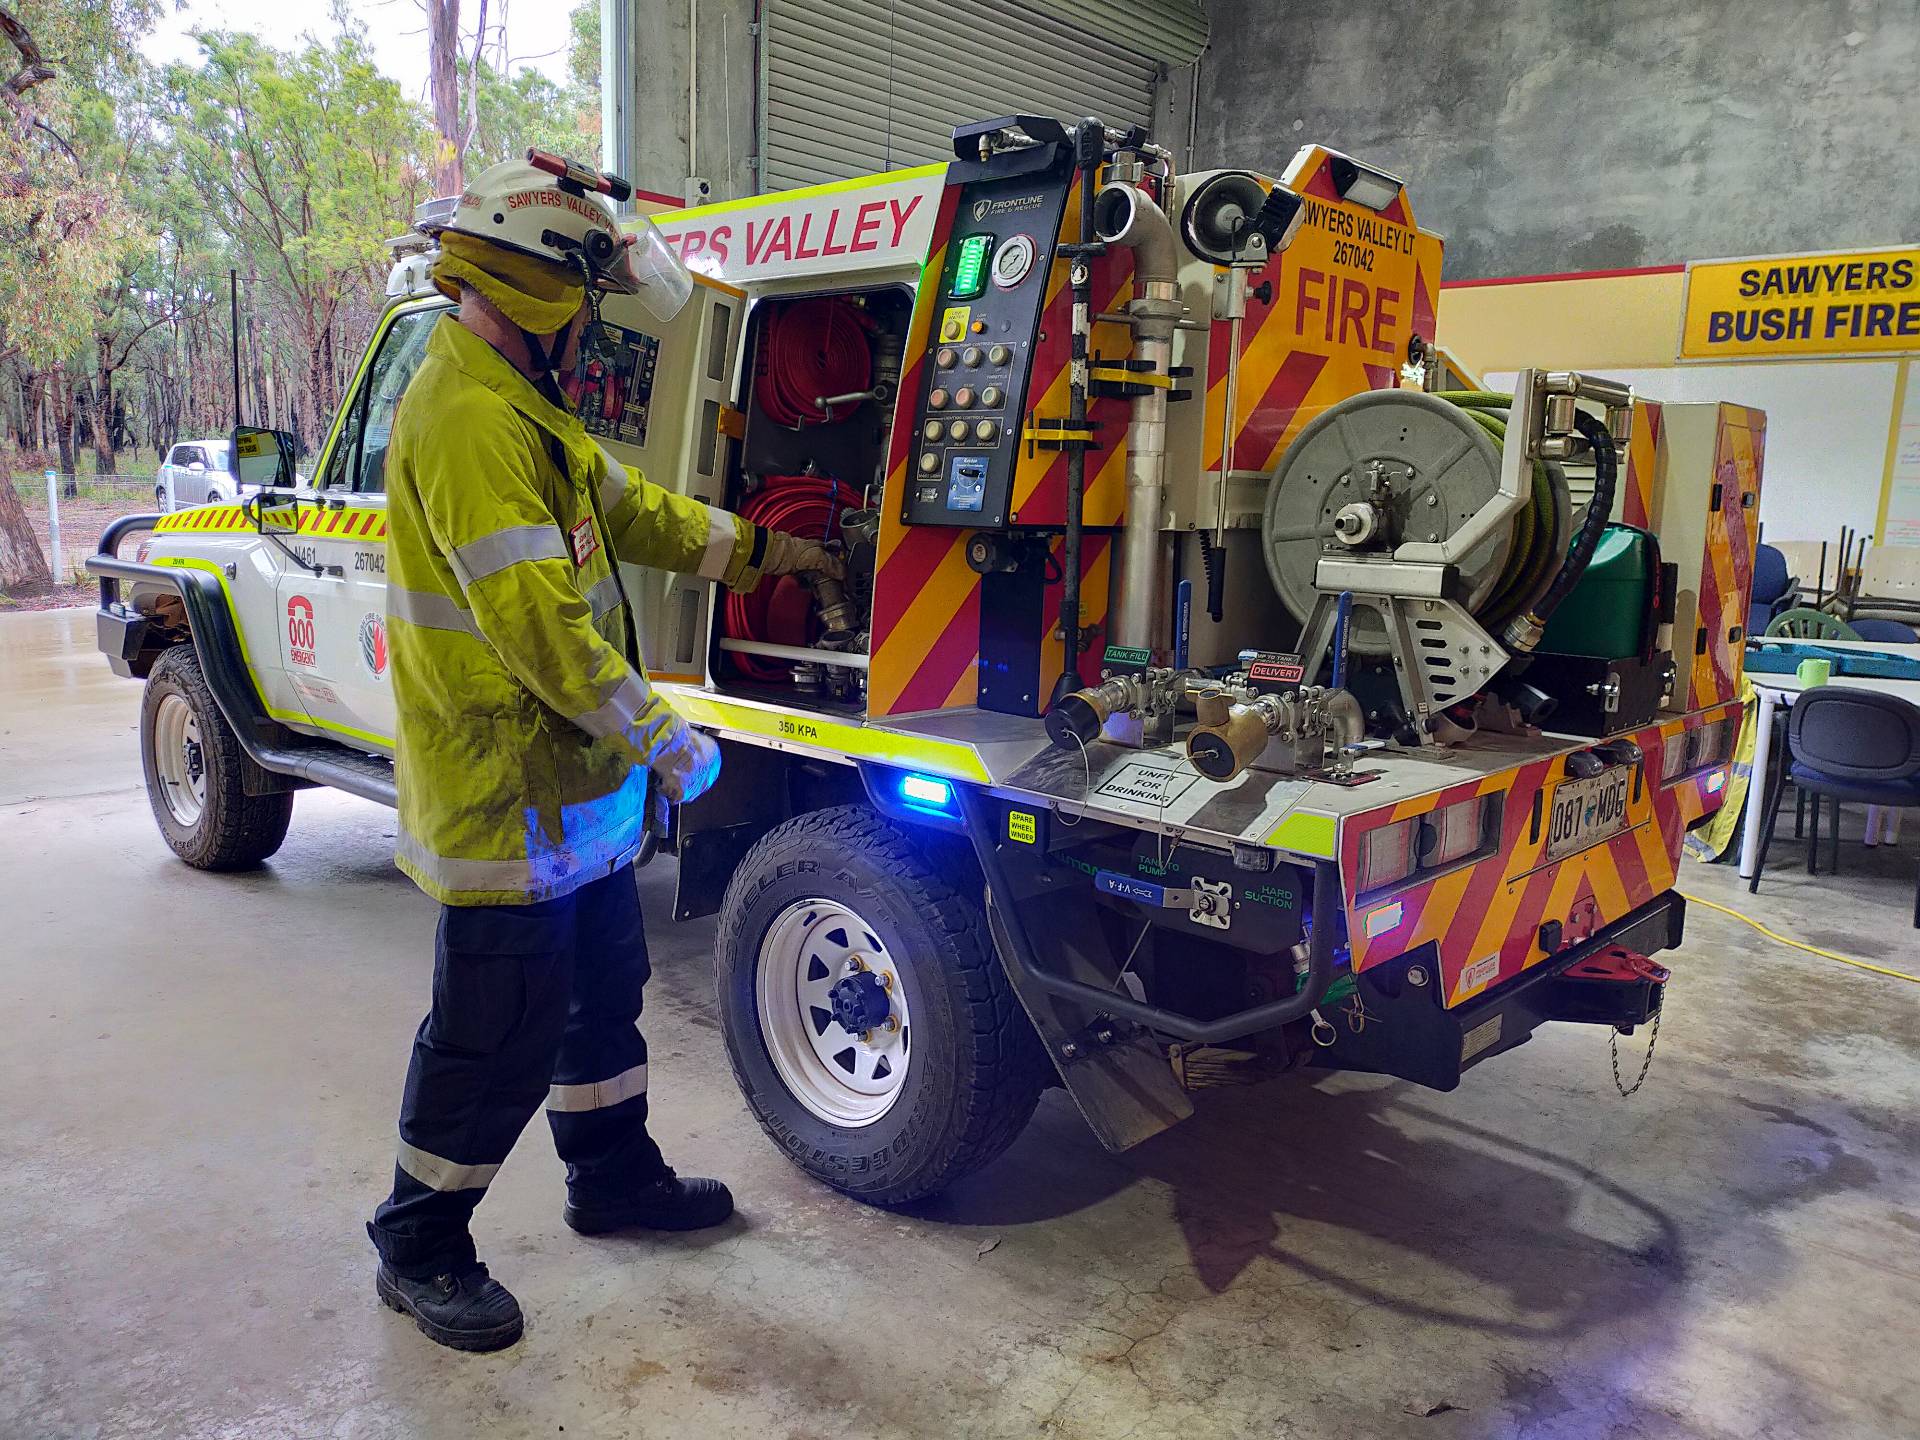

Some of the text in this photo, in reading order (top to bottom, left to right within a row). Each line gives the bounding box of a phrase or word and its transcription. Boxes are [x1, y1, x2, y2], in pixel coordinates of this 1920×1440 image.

[508, 191, 562, 209] SAWYERS
[566, 196, 602, 225] VALLEY
[992, 195, 1044, 209] FRONTLINE
[746, 195, 924, 266] VALLEY
[1357, 216, 1402, 253] VALLEY
[1403, 231, 1416, 256] LT
[1333, 240, 1375, 272] 267042
[1738, 259, 1914, 297] SAWYERS
[1295, 267, 1400, 354] FIRE
[1707, 302, 1920, 343] BUSH FIRE
[354, 552, 385, 573] 267042
[288, 617, 315, 650] 000
[291, 649, 316, 666] EMERGENCY
[1107, 649, 1148, 662] TANK FILL
[1254, 666, 1299, 678] DELIVERY
[778, 720, 818, 740] 350 KPA
[1134, 780, 1162, 790] FOR
[1137, 769, 1178, 782] UNFIT
[1105, 784, 1170, 803] DRINKING
[1596, 779, 1625, 827] MDG
[1011, 812, 1033, 824] SPARE
[1011, 822, 1034, 833] WHEEL
[1010, 830, 1035, 842] WINDER
[1138, 863, 1167, 877] PUMP
[1168, 862, 1180, 872] TO
[1244, 890, 1293, 910] SUCTION
[1261, 884, 1293, 900] HARD
